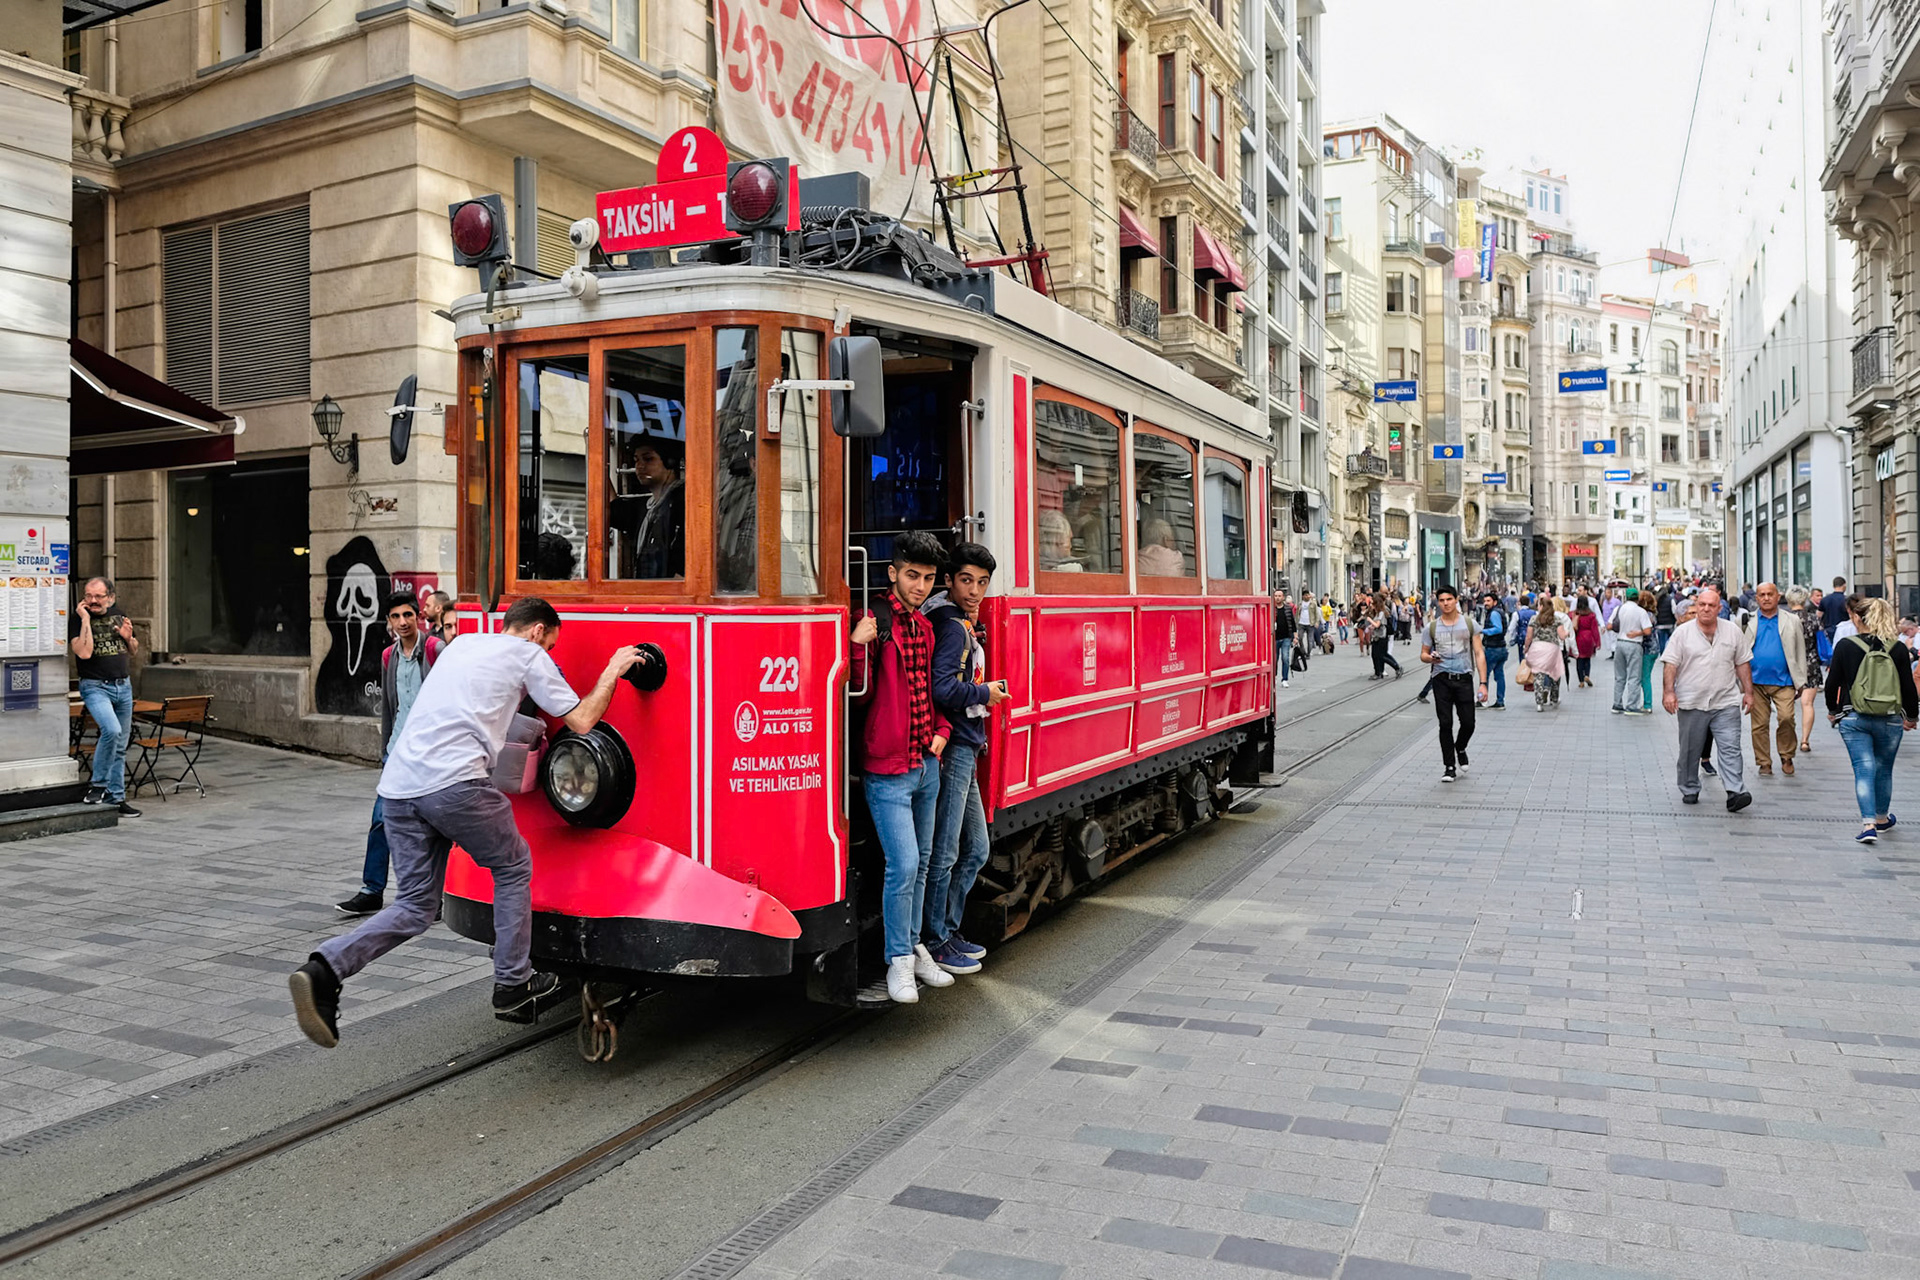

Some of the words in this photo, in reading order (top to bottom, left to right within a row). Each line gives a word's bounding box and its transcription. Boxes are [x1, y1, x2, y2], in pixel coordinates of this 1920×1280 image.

[682, 133, 698, 173] 2
[603, 193, 675, 239] TAKSİM
[1572, 377, 1604, 385] TURKCELL
[1498, 524, 1523, 536] LEFON
[17, 555, 50, 565] SETCARD
[759, 656, 799, 693] 223
[762, 722, 789, 735] ALO
[792, 720, 813, 733] 153
[731, 756, 785, 771] ASILMAK
[787, 753, 820, 770] YASAK
[729, 778, 745, 792] VE
[747, 771, 822, 793] TEHLİKELİDİR
